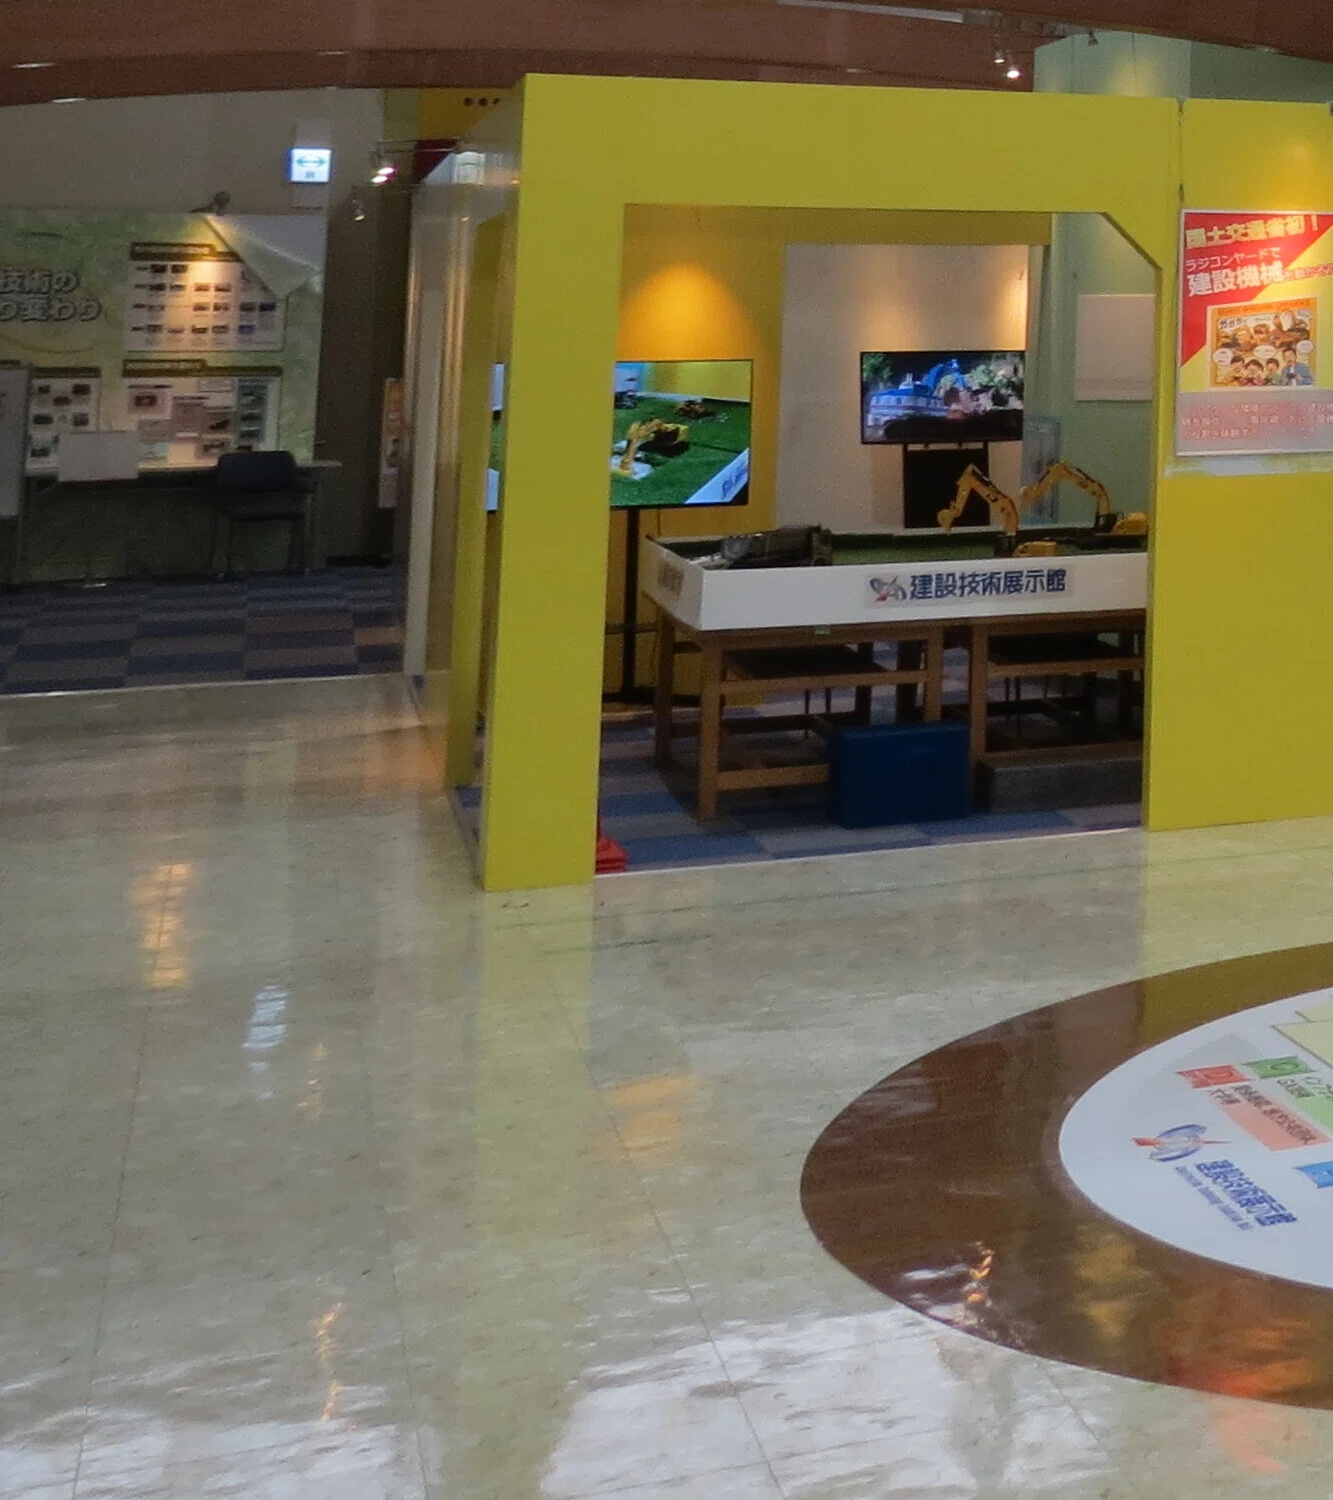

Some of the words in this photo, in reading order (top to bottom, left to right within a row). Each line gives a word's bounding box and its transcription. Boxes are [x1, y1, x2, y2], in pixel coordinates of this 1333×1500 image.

[1186, 246, 1281, 272] ラジコンヤードで
[908, 568, 1068, 601] 建設技術展示館
